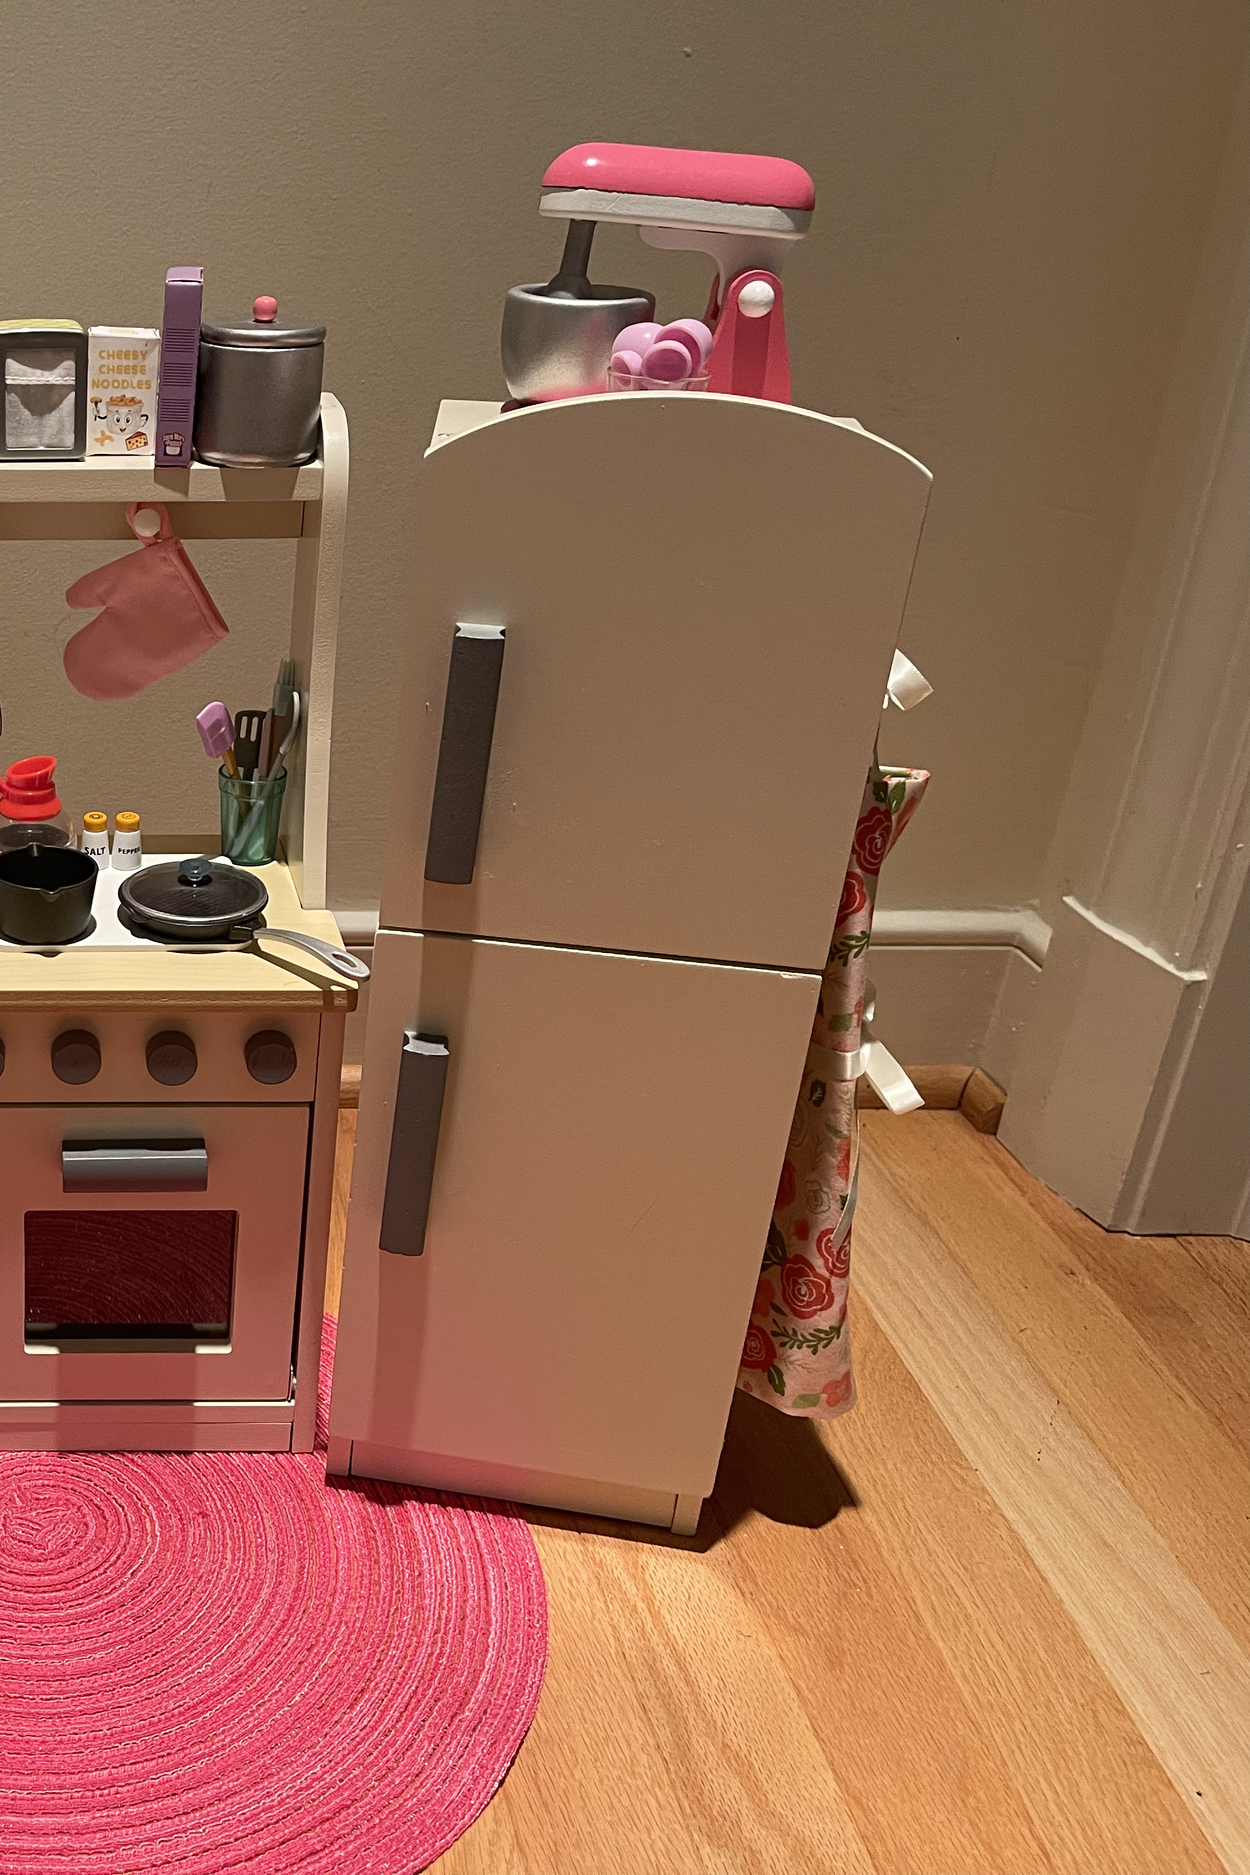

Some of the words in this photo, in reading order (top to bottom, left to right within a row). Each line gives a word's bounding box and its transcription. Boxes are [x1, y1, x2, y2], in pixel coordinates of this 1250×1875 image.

[98, 349, 148, 360] CHEESY
[98, 364, 147, 375] CHEESE
[91, 378, 152, 390] NOODLES
[84, 846, 106, 856] SALT
[117, 846, 141, 855] PEPPER
